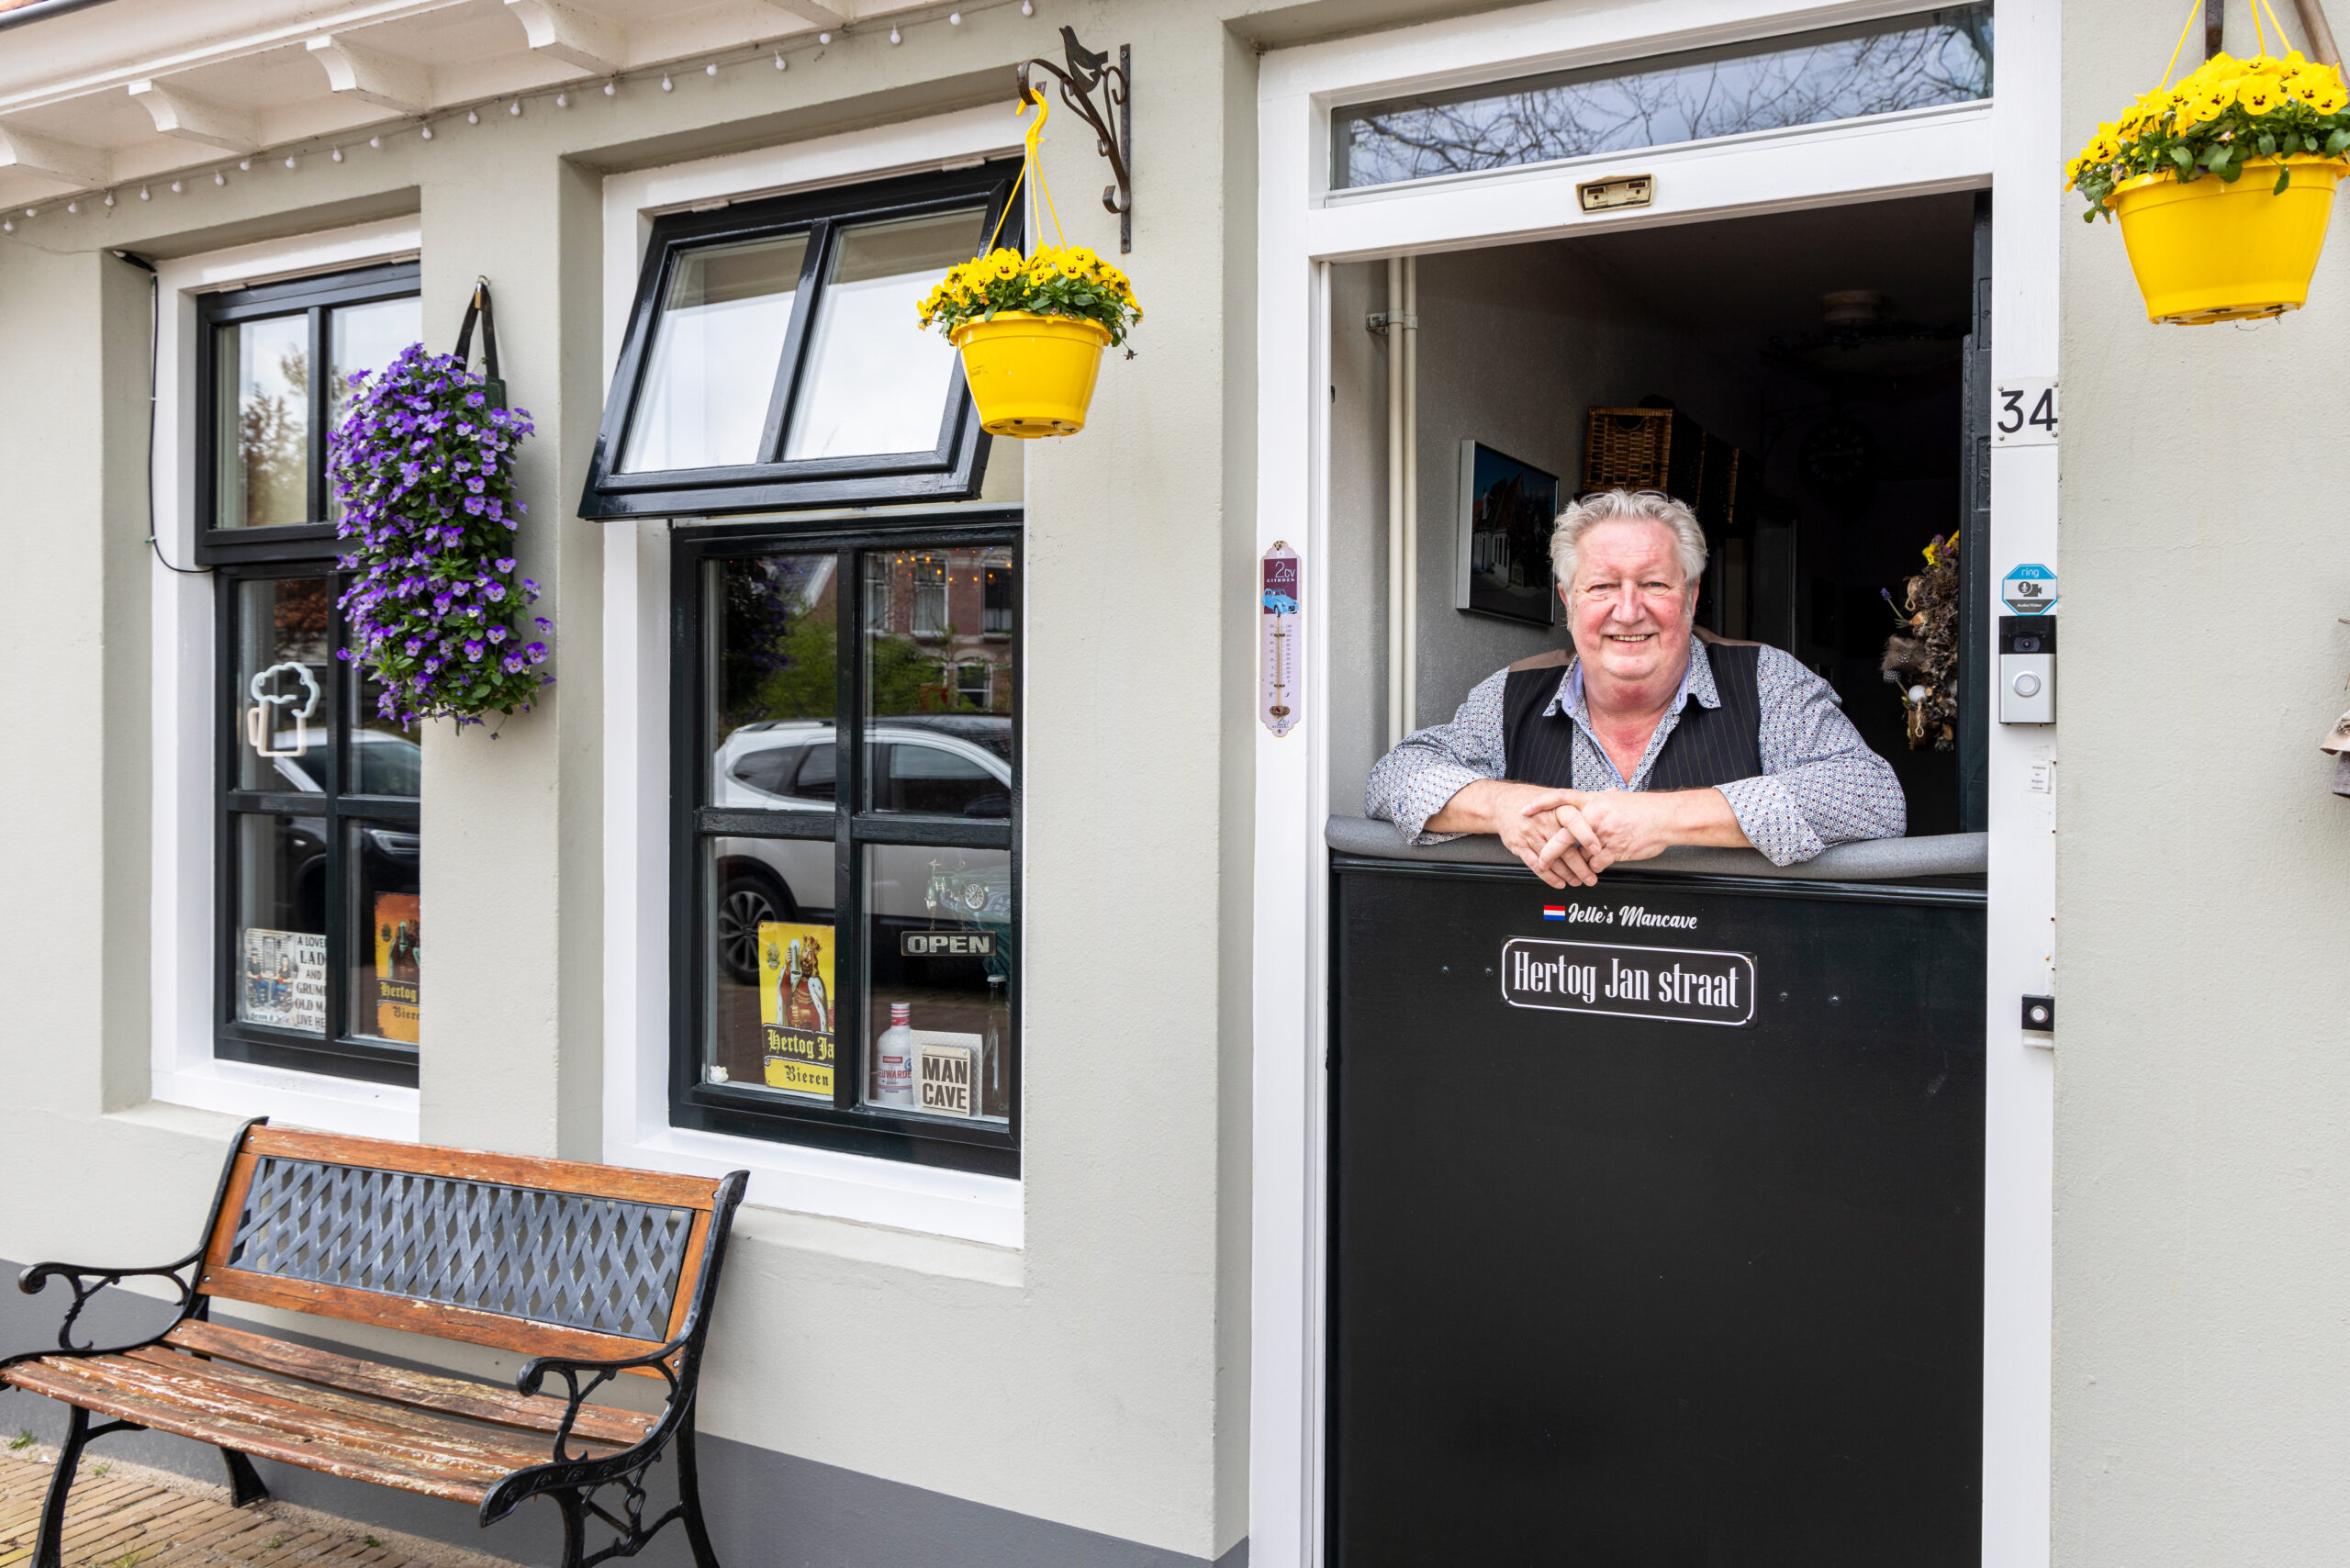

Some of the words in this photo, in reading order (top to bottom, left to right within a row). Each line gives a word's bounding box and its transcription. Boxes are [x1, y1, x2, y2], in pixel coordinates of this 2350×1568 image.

[1997, 388, 2058, 433] 34
[2021, 567, 2040, 578] ring
[1618, 905, 1697, 930] Mancave
[907, 935, 990, 954] OPEN
[306, 969, 322, 980] AND
[1513, 950, 1597, 1004] Hertog
[1605, 958, 1651, 1002] Jan
[1658, 963, 1740, 1009] straat
[380, 981, 417, 1003] Hertog
[295, 998, 314, 1011] OLD
[297, 1014, 312, 1026] LIVE
[767, 1029, 814, 1059] Hertog
[784, 1064, 830, 1087] Bieren
[922, 1056, 968, 1085] MAN
[922, 1082, 968, 1110] CAVE
